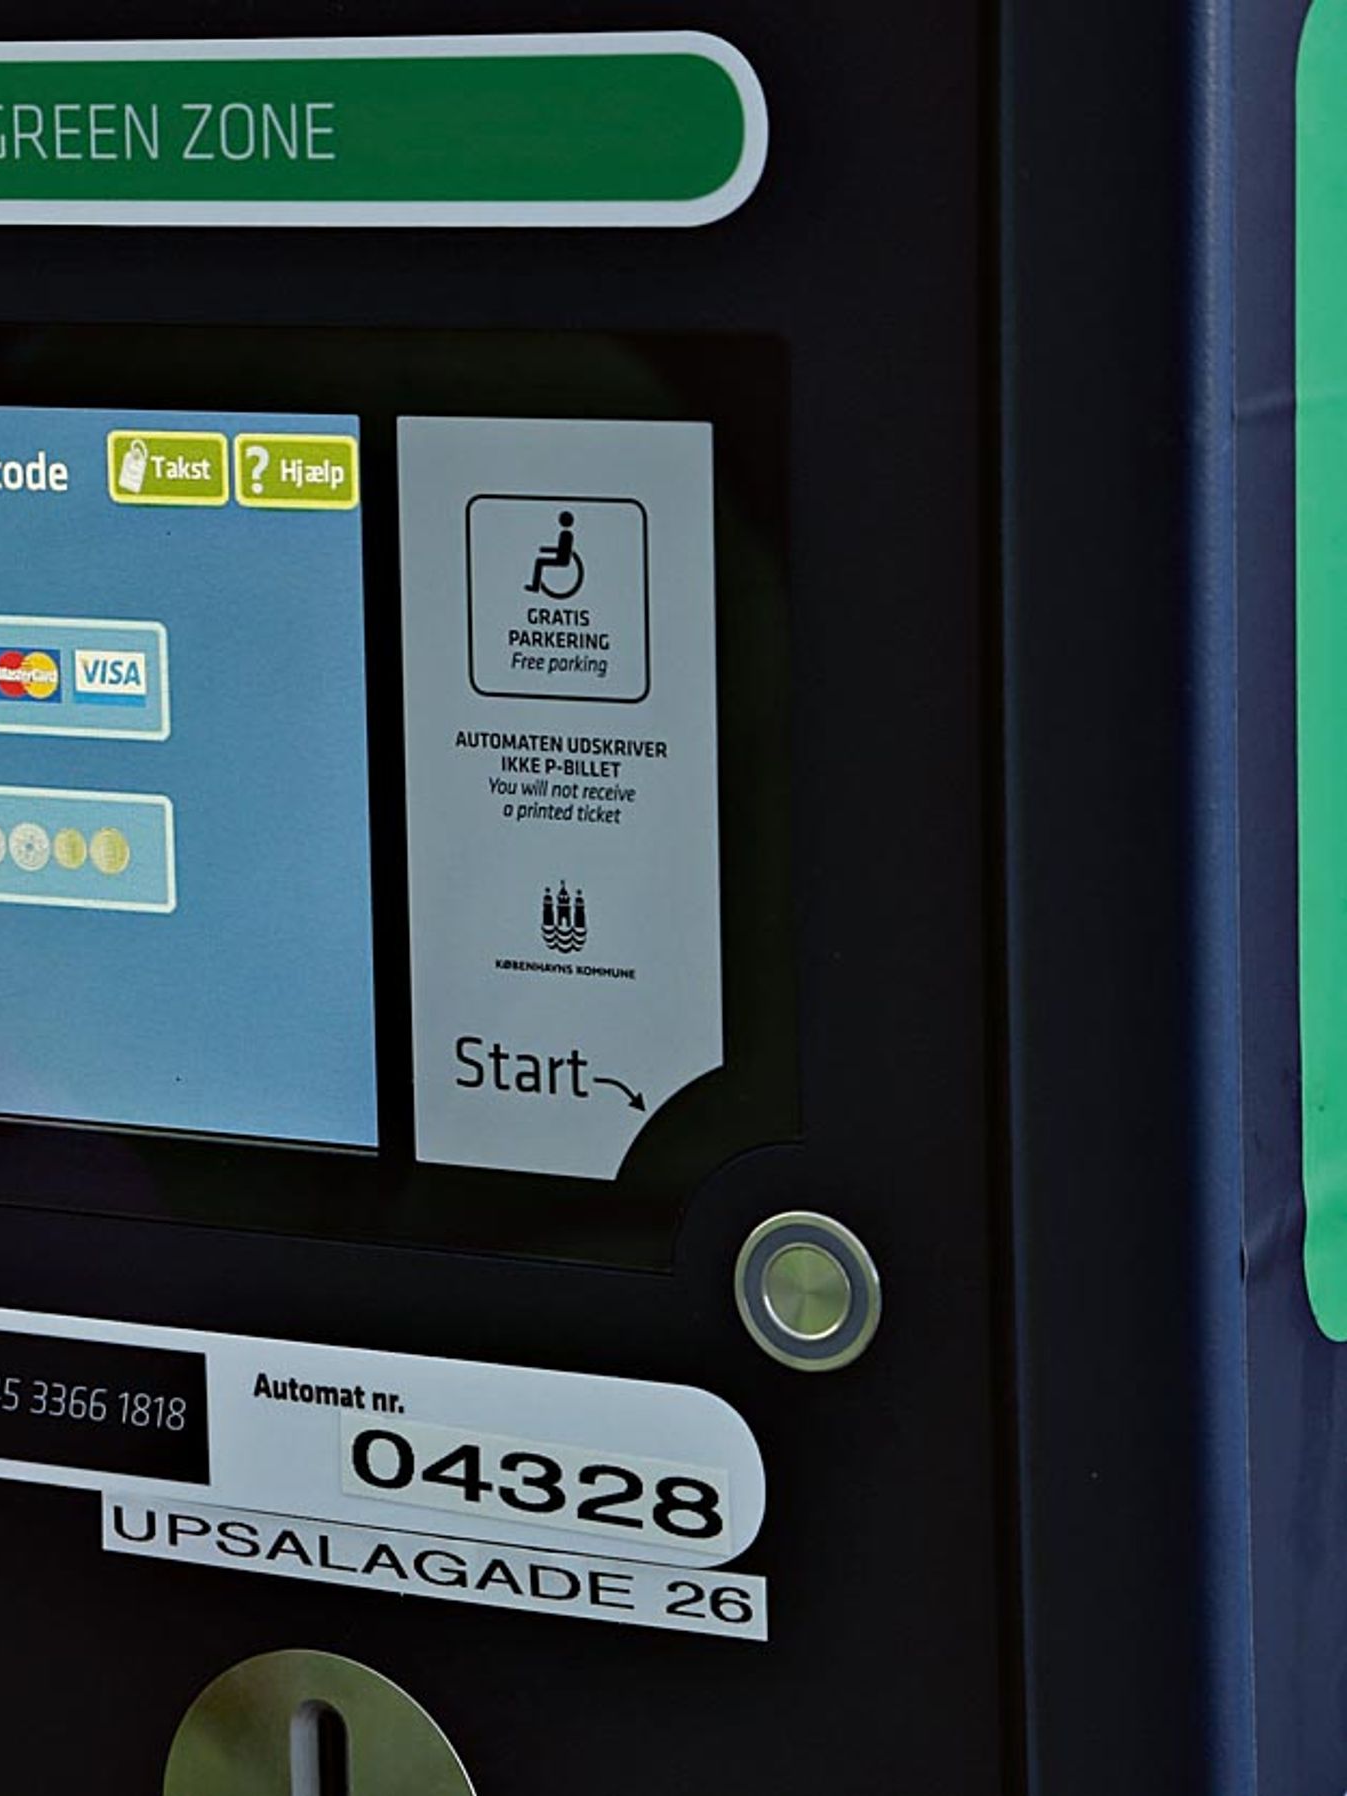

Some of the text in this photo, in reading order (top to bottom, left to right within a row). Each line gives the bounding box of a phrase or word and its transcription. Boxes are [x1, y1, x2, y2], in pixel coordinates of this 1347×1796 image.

[182, 102, 336, 162] ZONE
[152, 455, 210, 480] Takst
[281, 458, 344, 490] Hjælp
[527, 608, 590, 627] GRATIS
[508, 630, 610, 651] PARKERING
[82, 659, 142, 687] VISA
[511, 652, 608, 678] Free parking
[455, 731, 667, 759] AUTOMATEN UDSKRIVER
[502, 757, 622, 779] IKKE P-BILLET
[488, 777, 636, 803] You will not receive
[503, 802, 622, 825] a printed ticket
[495, 959, 636, 980] KØBENHAVNS KOMMUNE
[455, 1036, 589, 1098] Start
[29, 1380, 108, 1423] 3366
[118, 1392, 188, 1431] 1818
[253, 1372, 407, 1415] Automat nr.
[351, 1428, 725, 1540] 04328
[112, 1505, 755, 1624] UPSALAGADE 26
